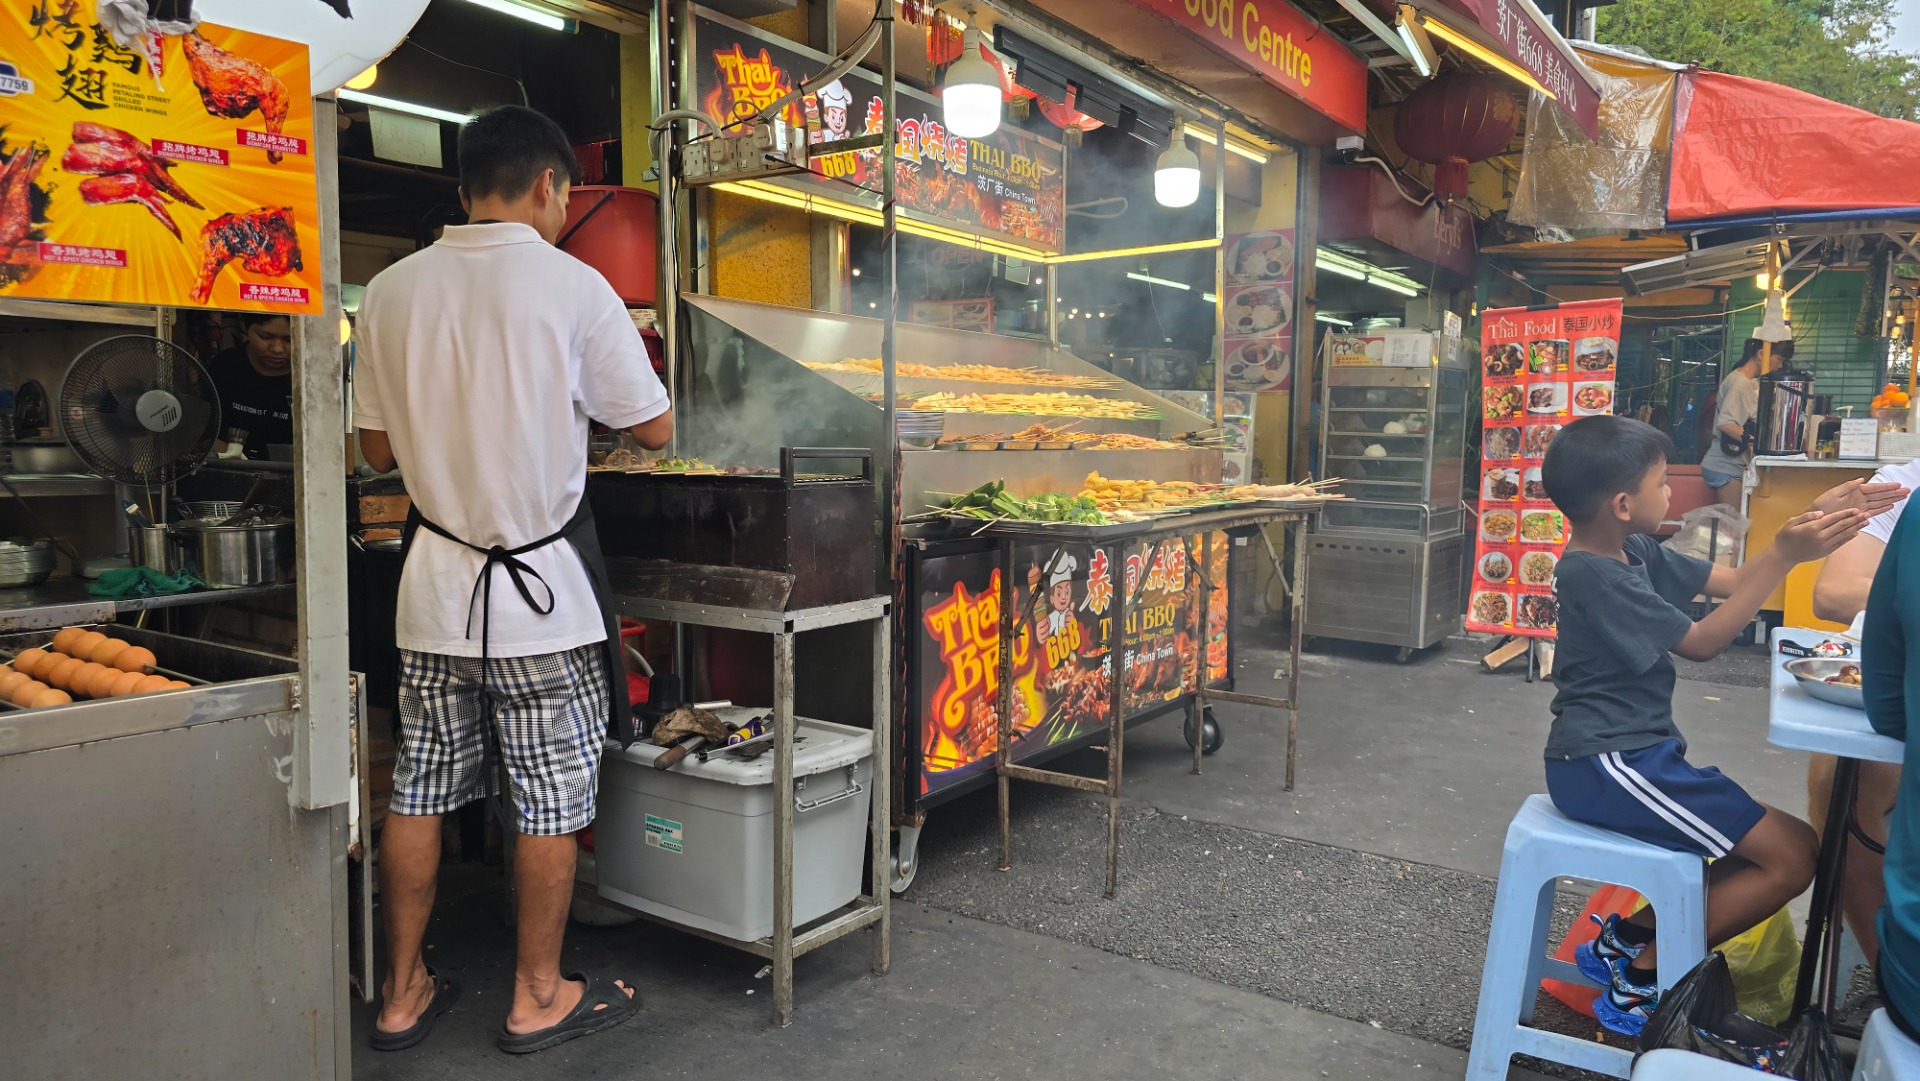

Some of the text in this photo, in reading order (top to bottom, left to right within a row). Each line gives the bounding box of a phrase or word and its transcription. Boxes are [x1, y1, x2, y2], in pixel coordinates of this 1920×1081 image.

[1242, 4, 1312, 87] Centre
[715, 46, 779, 96] Thai
[112, 82, 141, 92] FAMOUS
[113, 89, 171, 104] PETALING STREET
[113, 95, 142, 105] GRILLED
[113, 102, 168, 117] CHICKEN WINGS
[157, 150, 186, 160] SIGNATURE
[162, 141, 221, 159] 招牌烤鸡翅
[970, 139, 1042, 182] THAI BBQ
[1004, 187, 1036, 205] China Town
[930, 246, 983, 266] OPEN
[1488, 317, 1556, 339] Thai Food
[1563, 315, 1615, 333] 泰国小炒
[1143, 602, 1176, 630] BBQ
[1046, 617, 1081, 669] 668
[1136, 646, 1174, 665] China Town
